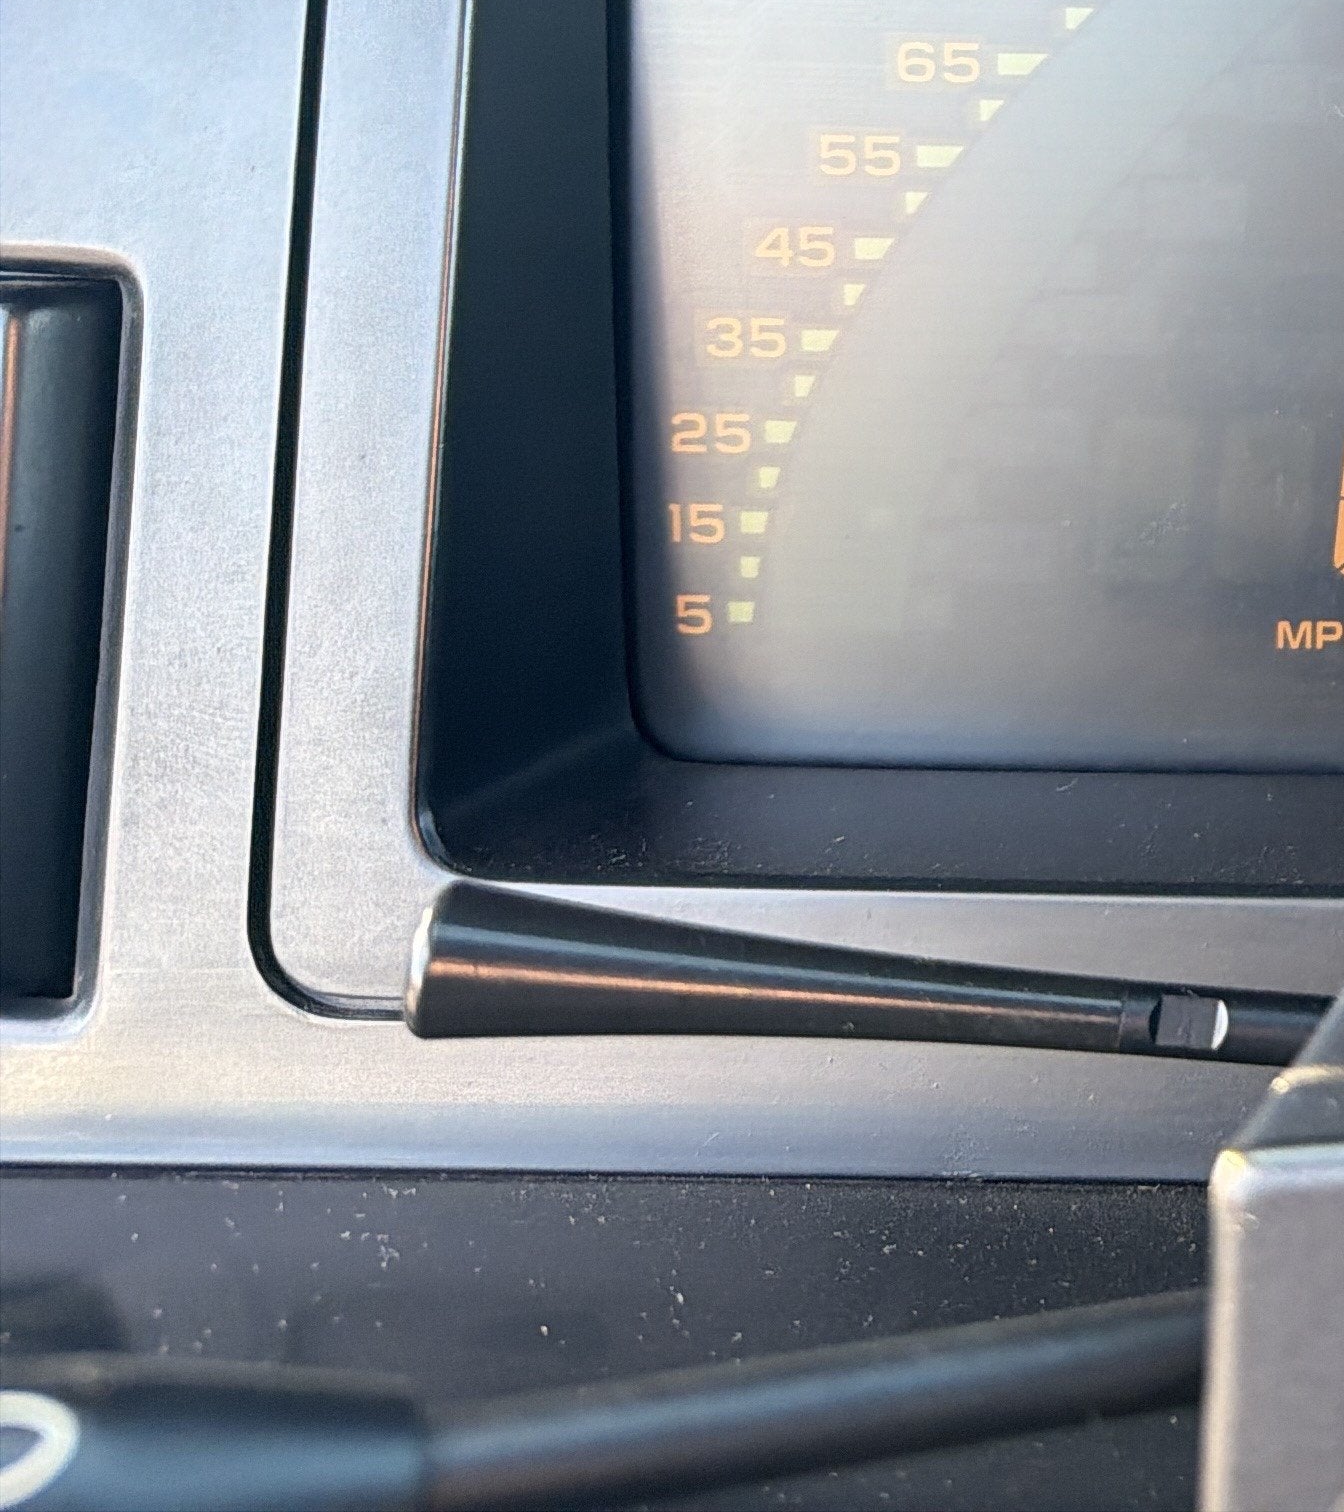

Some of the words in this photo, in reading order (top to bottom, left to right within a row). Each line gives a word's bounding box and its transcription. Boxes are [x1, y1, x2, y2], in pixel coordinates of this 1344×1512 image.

[896, 41, 980, 83] 65
[817, 134, 900, 176] 55
[753, 226, 835, 267] 45
[706, 317, 786, 357] 35
[671, 412, 751, 453] 25
[669, 504, 726, 544] 15
[677, 594, 714, 635] 5
